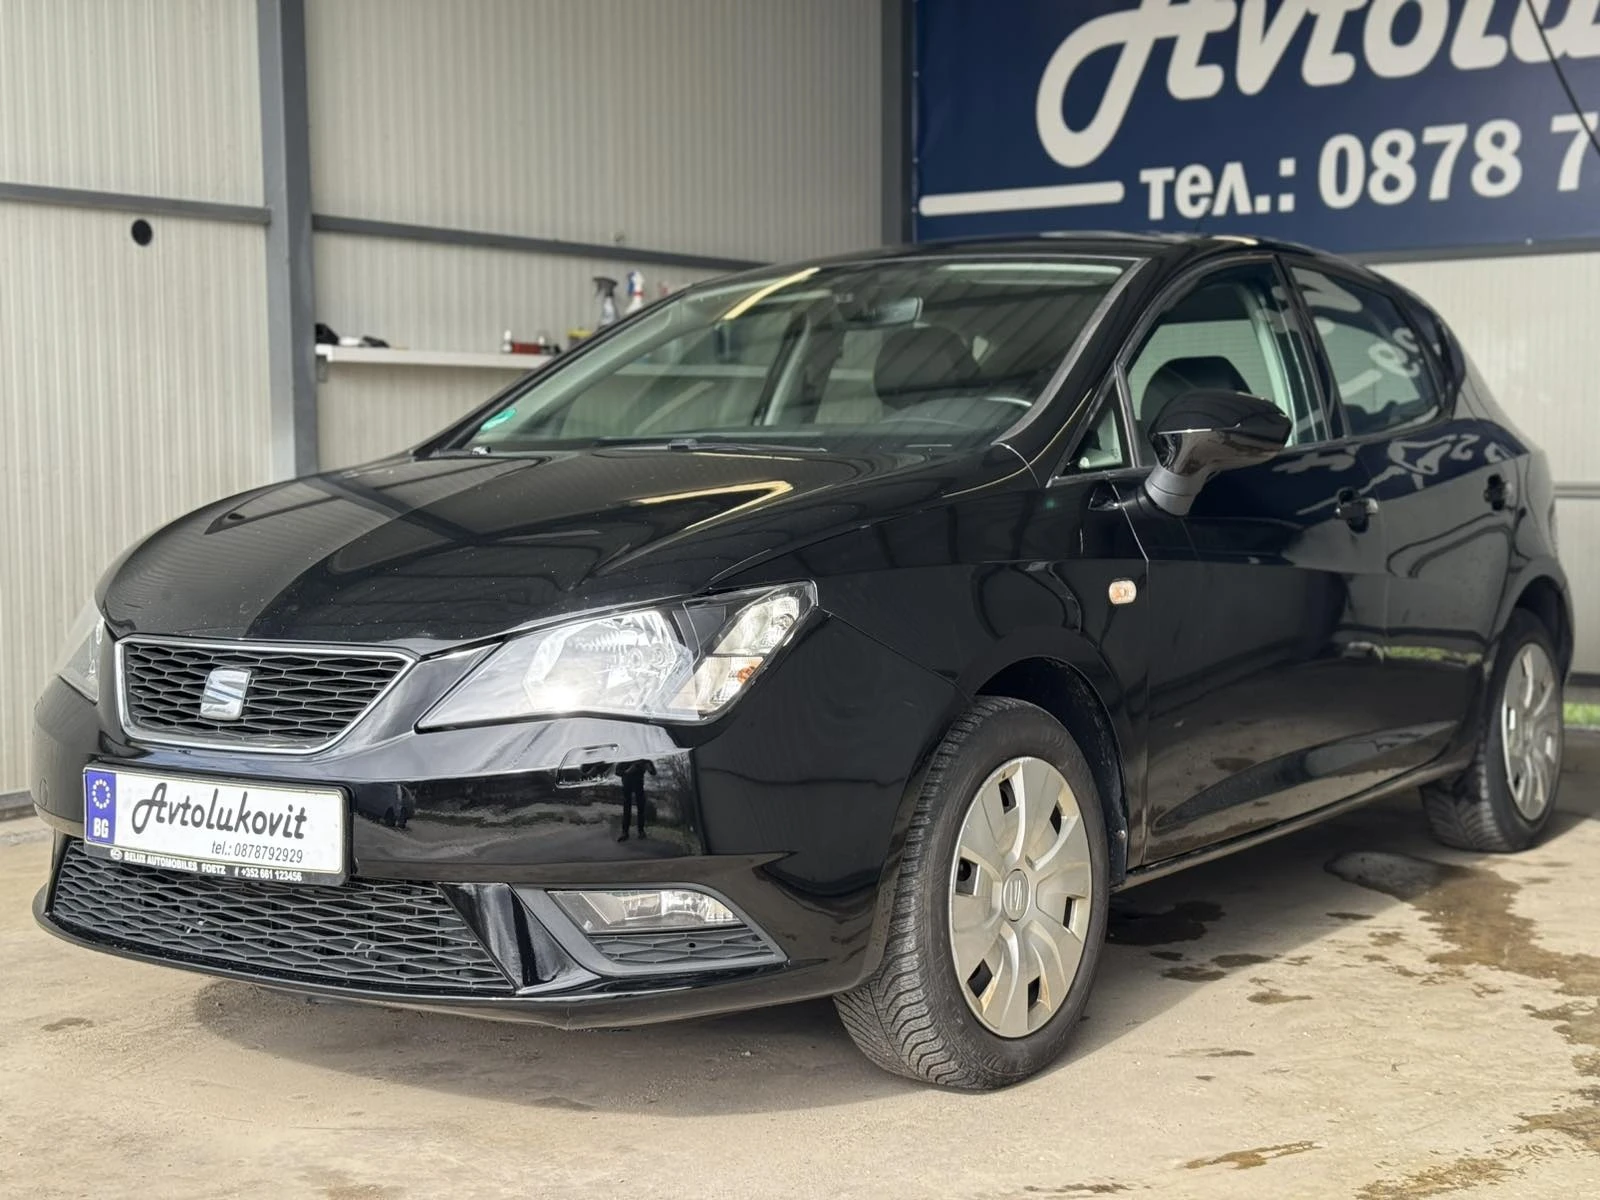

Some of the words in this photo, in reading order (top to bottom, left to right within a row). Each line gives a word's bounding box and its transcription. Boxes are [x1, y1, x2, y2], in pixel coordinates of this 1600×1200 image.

[1139, 157, 1296, 220] тел.:
[1318, 118, 1523, 209] 0878
[131, 782, 308, 840] Avtolukovit
[93, 817, 109, 839] BG
[211, 839, 232, 857] tel.:
[234, 842, 304, 864] 0878792929
[147, 855, 198, 872] AUTOMOBILES
[241, 867, 259, 879] +352
[275, 871, 303, 882] 123456
